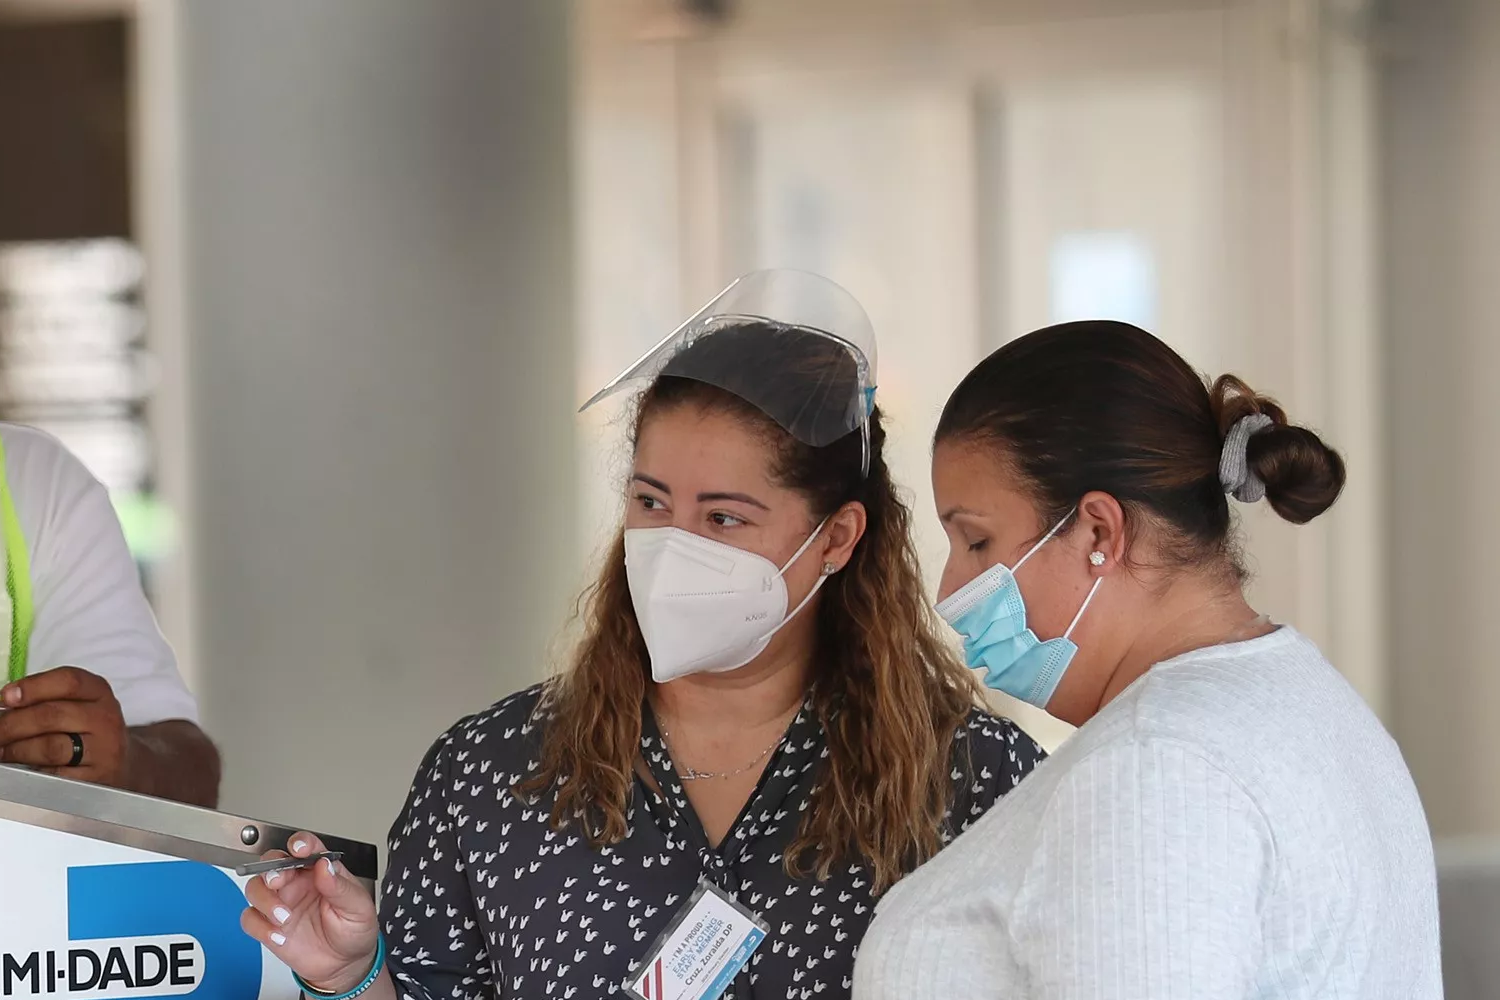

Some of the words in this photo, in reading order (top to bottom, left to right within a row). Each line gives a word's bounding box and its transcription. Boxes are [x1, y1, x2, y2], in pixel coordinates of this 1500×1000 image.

[672, 947, 695, 974] EARLY
[692, 917, 718, 948] VOTING
[676, 954, 698, 980] STAFF
[695, 919, 725, 955] MEMBER
[684, 921, 704, 943] PROUD
[684, 964, 703, 987] Cruz,
[700, 935, 726, 966] Zoraida
[722, 923, 735, 937] DP
